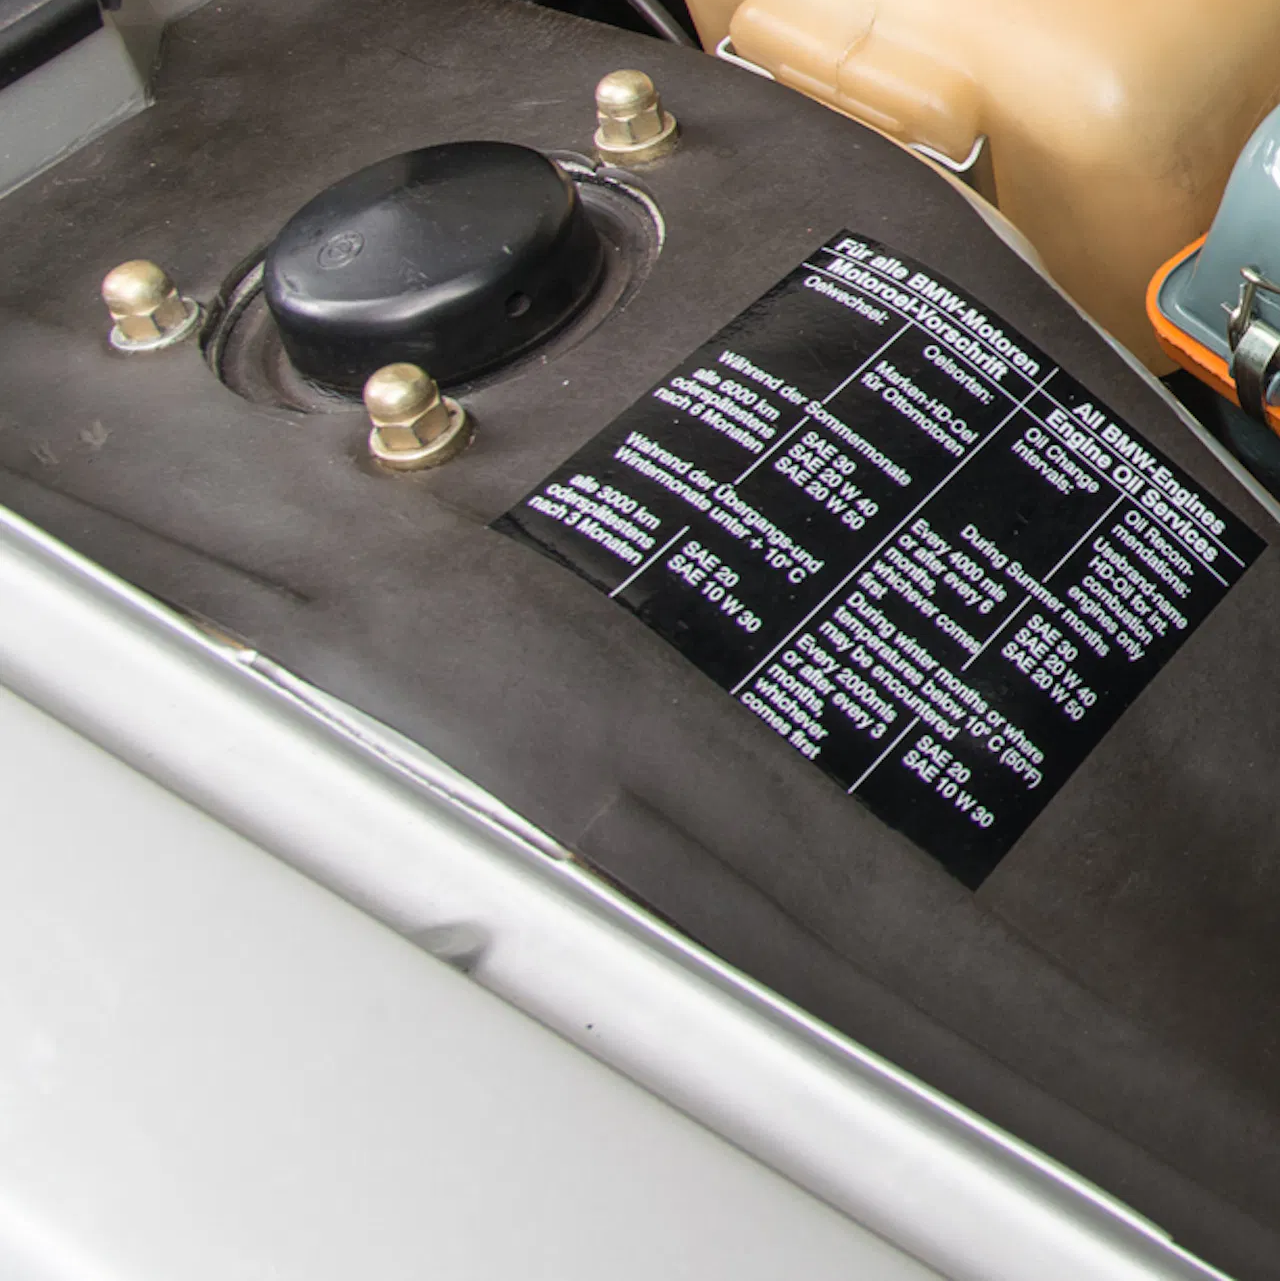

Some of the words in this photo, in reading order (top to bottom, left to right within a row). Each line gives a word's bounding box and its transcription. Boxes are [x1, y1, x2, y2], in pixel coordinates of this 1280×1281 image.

[803, 275, 889, 325] Oelwechsel:
[826, 256, 1008, 381] Motoroel-Vorschrift
[834, 238, 874, 260] Für
[869, 255, 909, 280] alle
[906, 272, 1040, 377] BMW-Motoren
[692, 368, 721, 386] alle
[718, 379, 758, 405] 6000
[753, 398, 780, 421] km
[875, 360, 979, 444] Marken-HD-Oel
[923, 345, 994, 404] Oelsorten:
[653, 387, 692, 410] nach
[689, 402, 707, 416] 6
[699, 408, 764, 454] Monaten
[779, 386, 808, 405] der
[804, 400, 911, 486] Sommermonate
[801, 431, 839, 461] SAE
[832, 455, 856, 475] 30
[882, 387, 965, 457] Ottomotoren
[688, 470, 717, 490] der
[774, 456, 812, 486] SAE
[805, 480, 829, 501] 20
[826, 495, 848, 513] W
[842, 509, 865, 530] 50
[788, 443, 825, 474] SAE
[818, 468, 843, 488] 20
[840, 481, 861, 500] W
[856, 499, 879, 517] 40
[1012, 439, 1074, 495] Intervals:
[1025, 427, 1049, 449] Oil
[1046, 445, 1099, 493] Change
[1045, 408, 1112, 469] Engine
[1112, 465, 1145, 495] Oil
[1141, 489, 1218, 562] Services
[1072, 403, 1106, 430] All
[1101, 423, 1225, 535] BMW-Engines
[528, 495, 568, 520] nach
[564, 511, 583, 526] 3
[576, 517, 643, 565] Monaten
[569, 474, 600, 493] alle
[596, 485, 638, 514] 3000
[632, 506, 661, 530] km
[614, 445, 712, 511] Wintermonate
[709, 506, 751, 539] unter
[750, 538, 763, 549] +
[788, 567, 806, 583] C
[682, 541, 721, 572] SAE
[714, 566, 739, 587] 20
[884, 547, 936, 596] months,
[898, 534, 918, 550] or
[913, 547, 947, 575] after
[944, 572, 982, 605] every
[979, 599, 994, 614] 6
[911, 518, 951, 556] Every
[949, 551, 984, 581] 4000
[1111, 524, 1191, 598] mendations:
[1124, 510, 1149, 532] Oil
[1144, 526, 1194, 575] Recom-
[667, 554, 707, 586] SAE
[702, 581, 725, 601] 10
[721, 594, 744, 615] W
[737, 610, 762, 632] 30
[858, 572, 888, 599] first
[872, 560, 940, 617] whichever
[936, 614, 982, 654] comes
[961, 524, 1009, 569] During
[1006, 561, 1065, 612] Summer
[1061, 609, 1109, 656] months
[1082, 575, 1153, 645] combustion
[1088, 556, 1135, 599] HD-Oil
[1130, 594, 1151, 615] for
[796, 633, 841, 674] Every
[1027, 614, 1062, 646] SAE
[1056, 640, 1078, 661] 30
[1068, 586, 1118, 634] engines
[1116, 631, 1144, 660] only
[767, 663, 824, 717] months,
[782, 650, 804, 667] or
[799, 664, 836, 695] after
[832, 692, 874, 729] every
[870, 723, 887, 738] 3
[819, 621, 855, 652] may
[850, 645, 873, 668] be
[871, 665, 960, 740] encountered
[834, 606, 924, 685] temperatures
[921, 679, 967, 720] below
[987, 735, 1005, 752] C
[846, 591, 896, 639] During
[894, 632, 939, 671] winter
[934, 667, 988, 714] months
[986, 710, 1006, 727] or
[1003, 723, 1044, 764] where
[1002, 642, 1037, 674] SAE
[1031, 668, 1053, 689] 20
[1051, 683, 1070, 702] W
[1064, 699, 1084, 720] 50
[1015, 628, 1049, 660] SAE
[1043, 654, 1066, 675] 20
[1063, 669, 1082, 689] W
[1077, 688, 1097, 706] 40
[741, 692, 792, 735] comes
[789, 730, 821, 759] first
[755, 677, 828, 740] whichever
[903, 750, 940, 783] SAE
[936, 778, 958, 798] 10
[955, 791, 977, 811] W
[971, 806, 994, 827] 30
[916, 735, 953, 768] SAE
[947, 762, 971, 783] 20
